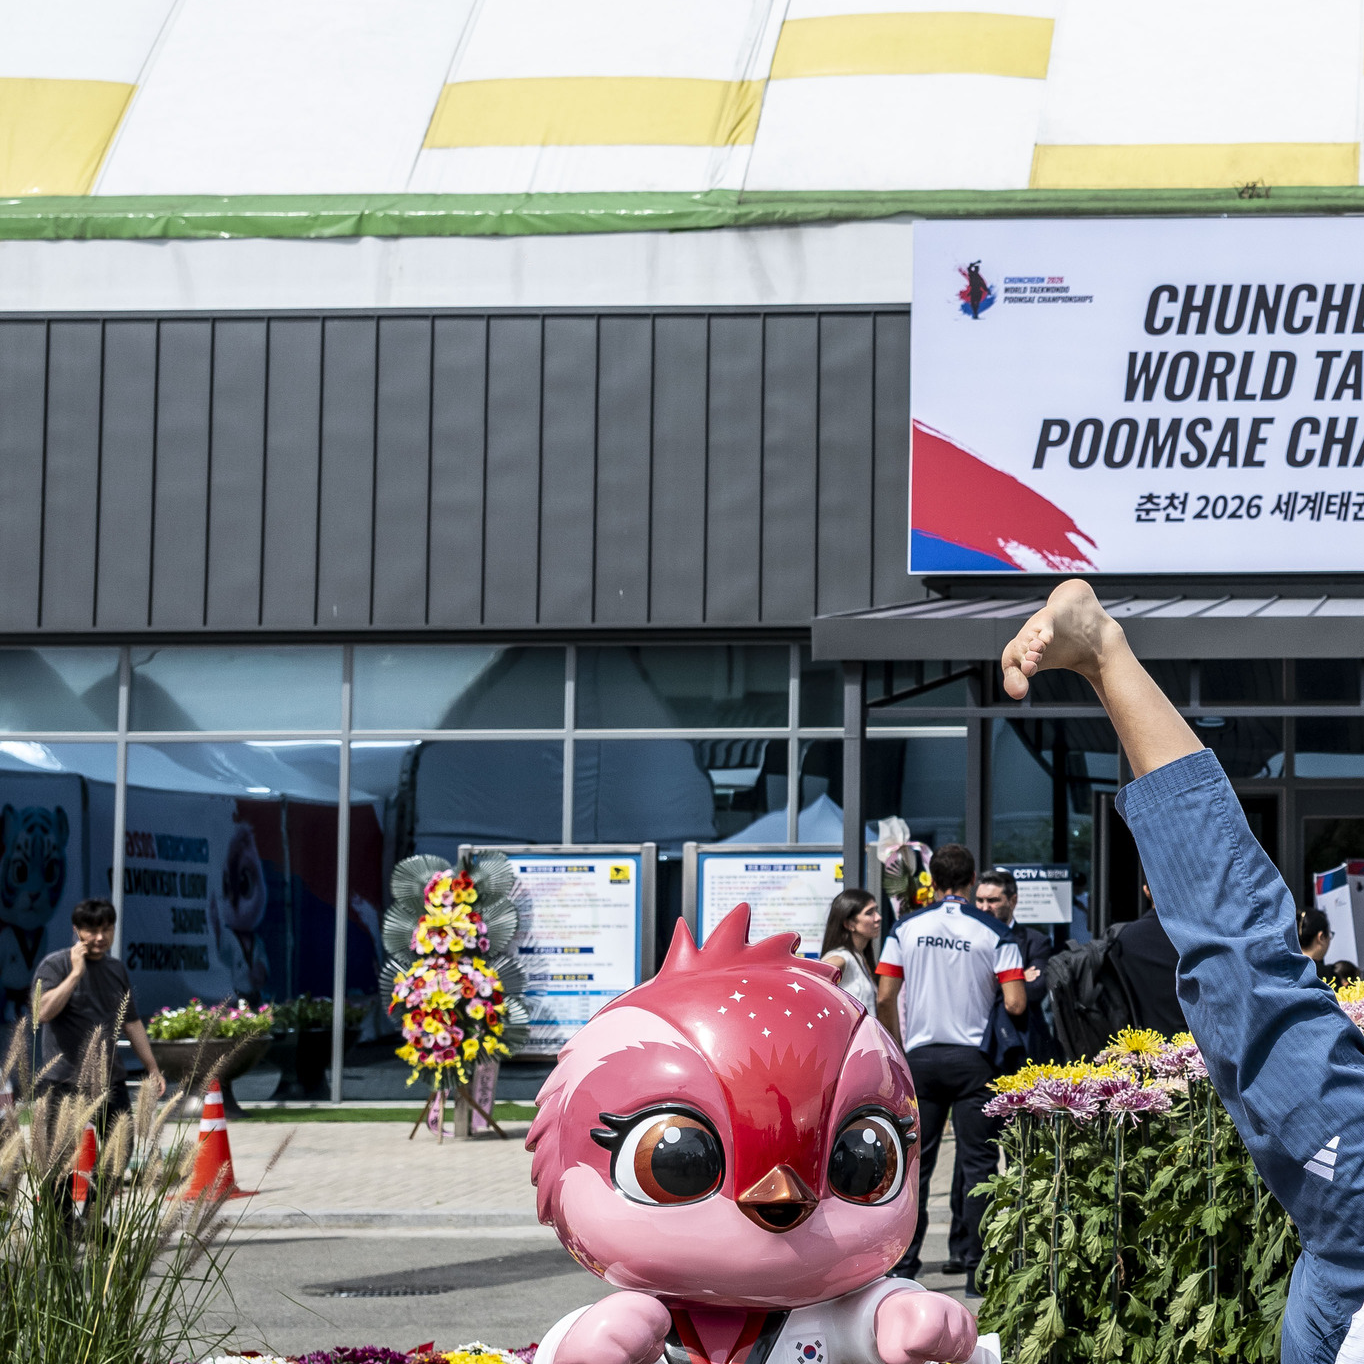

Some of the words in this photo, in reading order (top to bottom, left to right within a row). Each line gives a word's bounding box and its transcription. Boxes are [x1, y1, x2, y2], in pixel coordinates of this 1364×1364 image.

[1003, 286, 1028, 294] WORLD
[1029, 286, 1070, 294] TAEKWONDO
[1124, 350, 1297, 402] WORLD
[1032, 417, 1275, 470] POOMSAE
[1134, 494, 1189, 523] 춘천
[1195, 494, 1263, 521] 2026
[1013, 868, 1038, 879] CCTV
[917, 936, 972, 952] FRANCE
